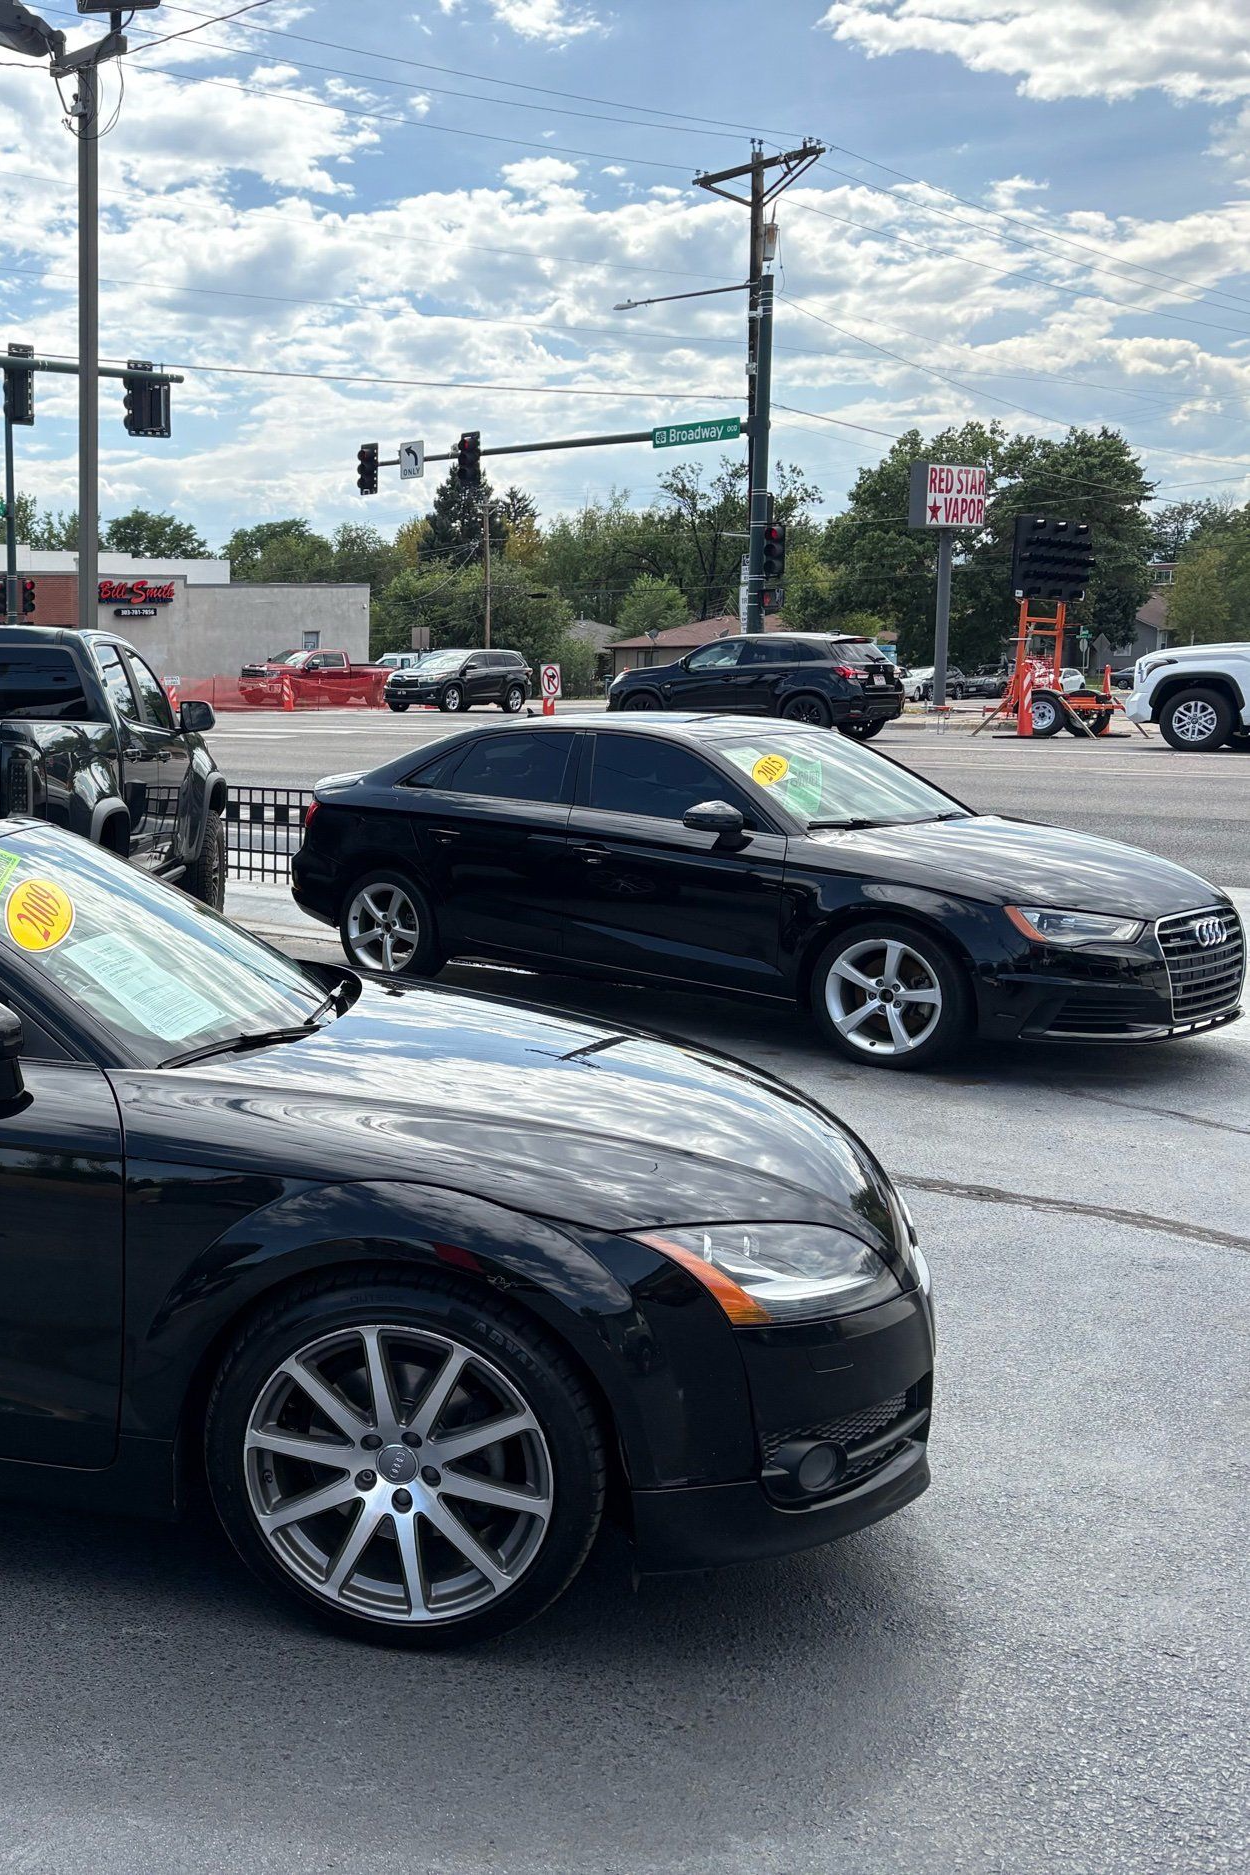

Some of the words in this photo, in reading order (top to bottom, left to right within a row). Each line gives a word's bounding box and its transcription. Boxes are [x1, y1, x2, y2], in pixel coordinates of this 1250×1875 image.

[670, 426, 724, 439] Broadway
[403, 467, 420, 476] ONLY
[929, 467, 954, 494] RED
[956, 469, 986, 495] STAR
[944, 497, 984, 524] VAPOR
[98, 580, 128, 599] Bill
[130, 580, 175, 604] Smith
[758, 757, 783, 782] 2015
[17, 883, 60, 942] 2009
